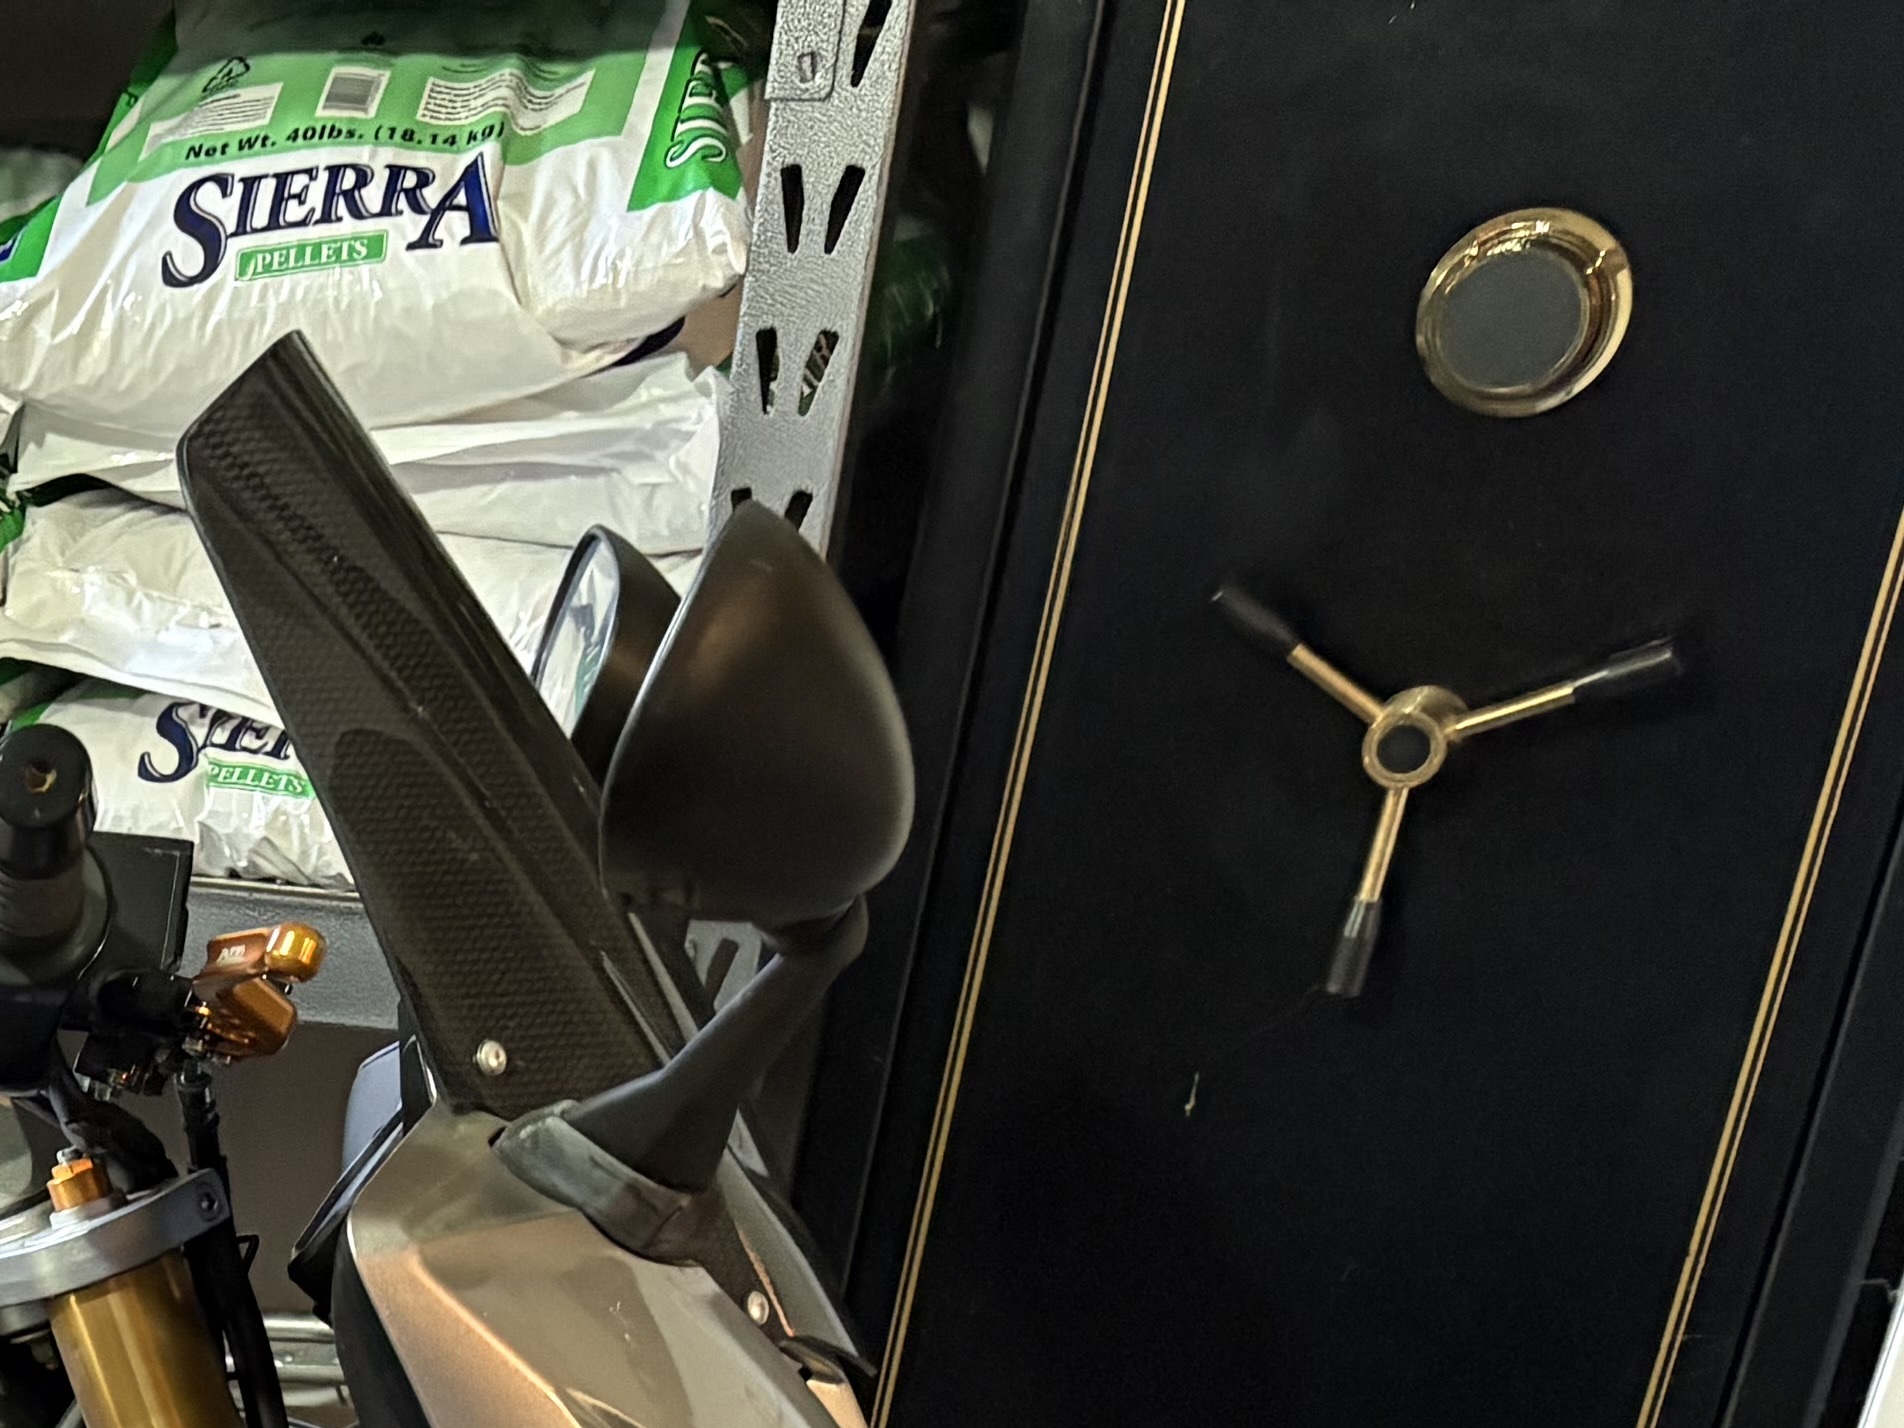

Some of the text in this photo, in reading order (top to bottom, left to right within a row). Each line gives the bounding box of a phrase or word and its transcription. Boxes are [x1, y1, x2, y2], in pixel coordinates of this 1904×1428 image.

[185, 140, 228, 160] Net
[238, 134, 277, 151] Wt.
[287, 123, 365, 143] 40lbs.
[161, 150, 500, 289] SIERRA
[246, 238, 370, 276] PELLETS
[207, 764, 307, 795] PELLETS
